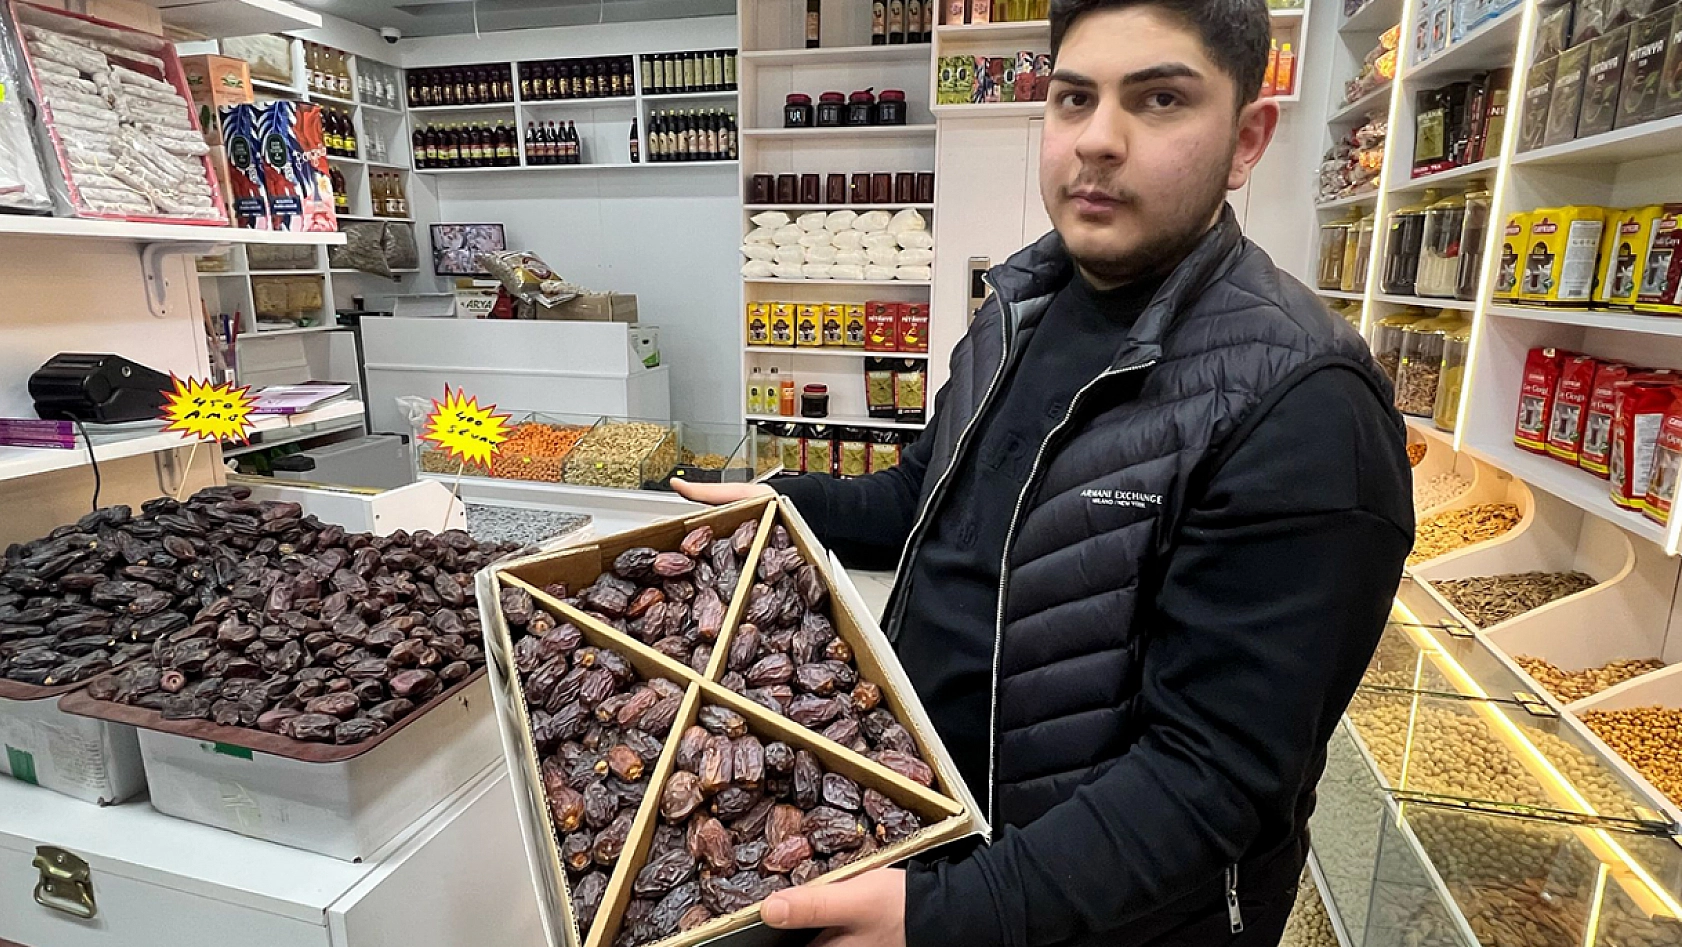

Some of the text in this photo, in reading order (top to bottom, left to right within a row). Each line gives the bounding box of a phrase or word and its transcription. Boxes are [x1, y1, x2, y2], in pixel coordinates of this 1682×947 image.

[466, 300, 492, 309] ARYA
[1080, 489, 1163, 505] ARMANI EXCHANGE
